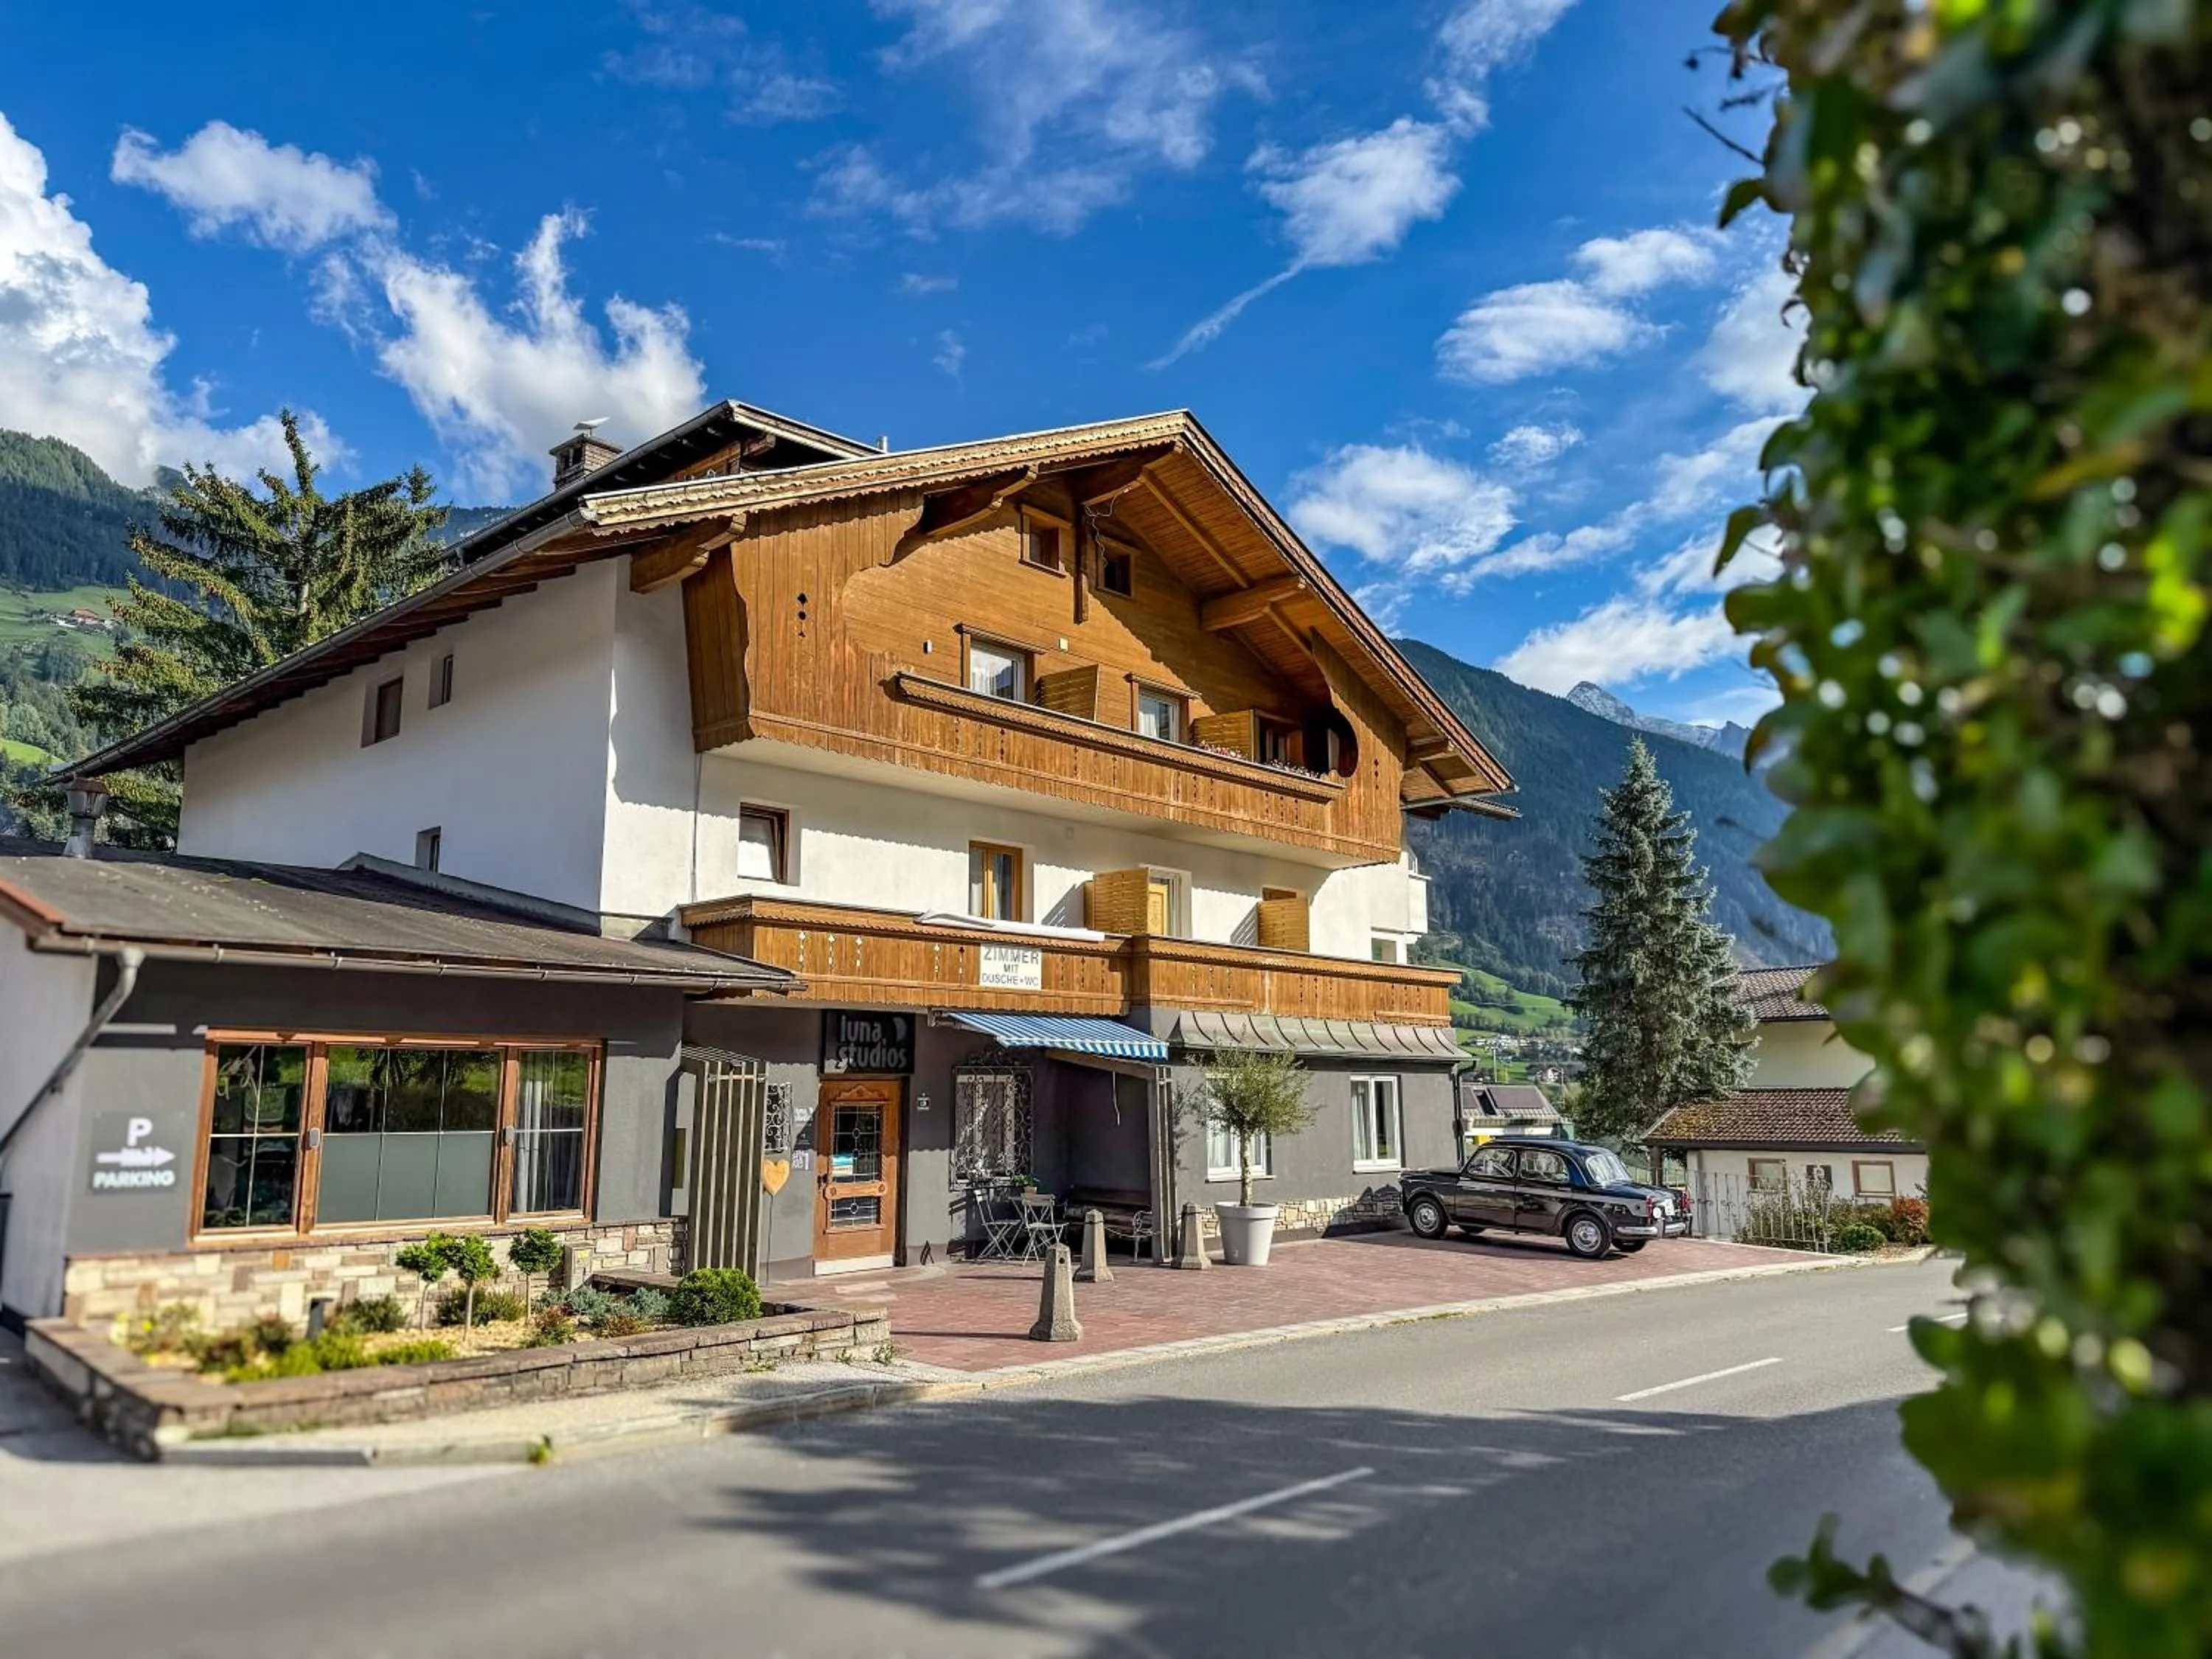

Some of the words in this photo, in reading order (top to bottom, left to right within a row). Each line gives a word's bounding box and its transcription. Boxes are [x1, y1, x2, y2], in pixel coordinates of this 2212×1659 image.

[984, 947, 1039, 964] ZIMMER
[1004, 963, 1019, 973] MIT
[840, 1014, 883, 1043] luna
[838, 1038, 908, 1068] studios
[127, 1117, 153, 1147] P
[93, 1169, 176, 1189] PARKING
